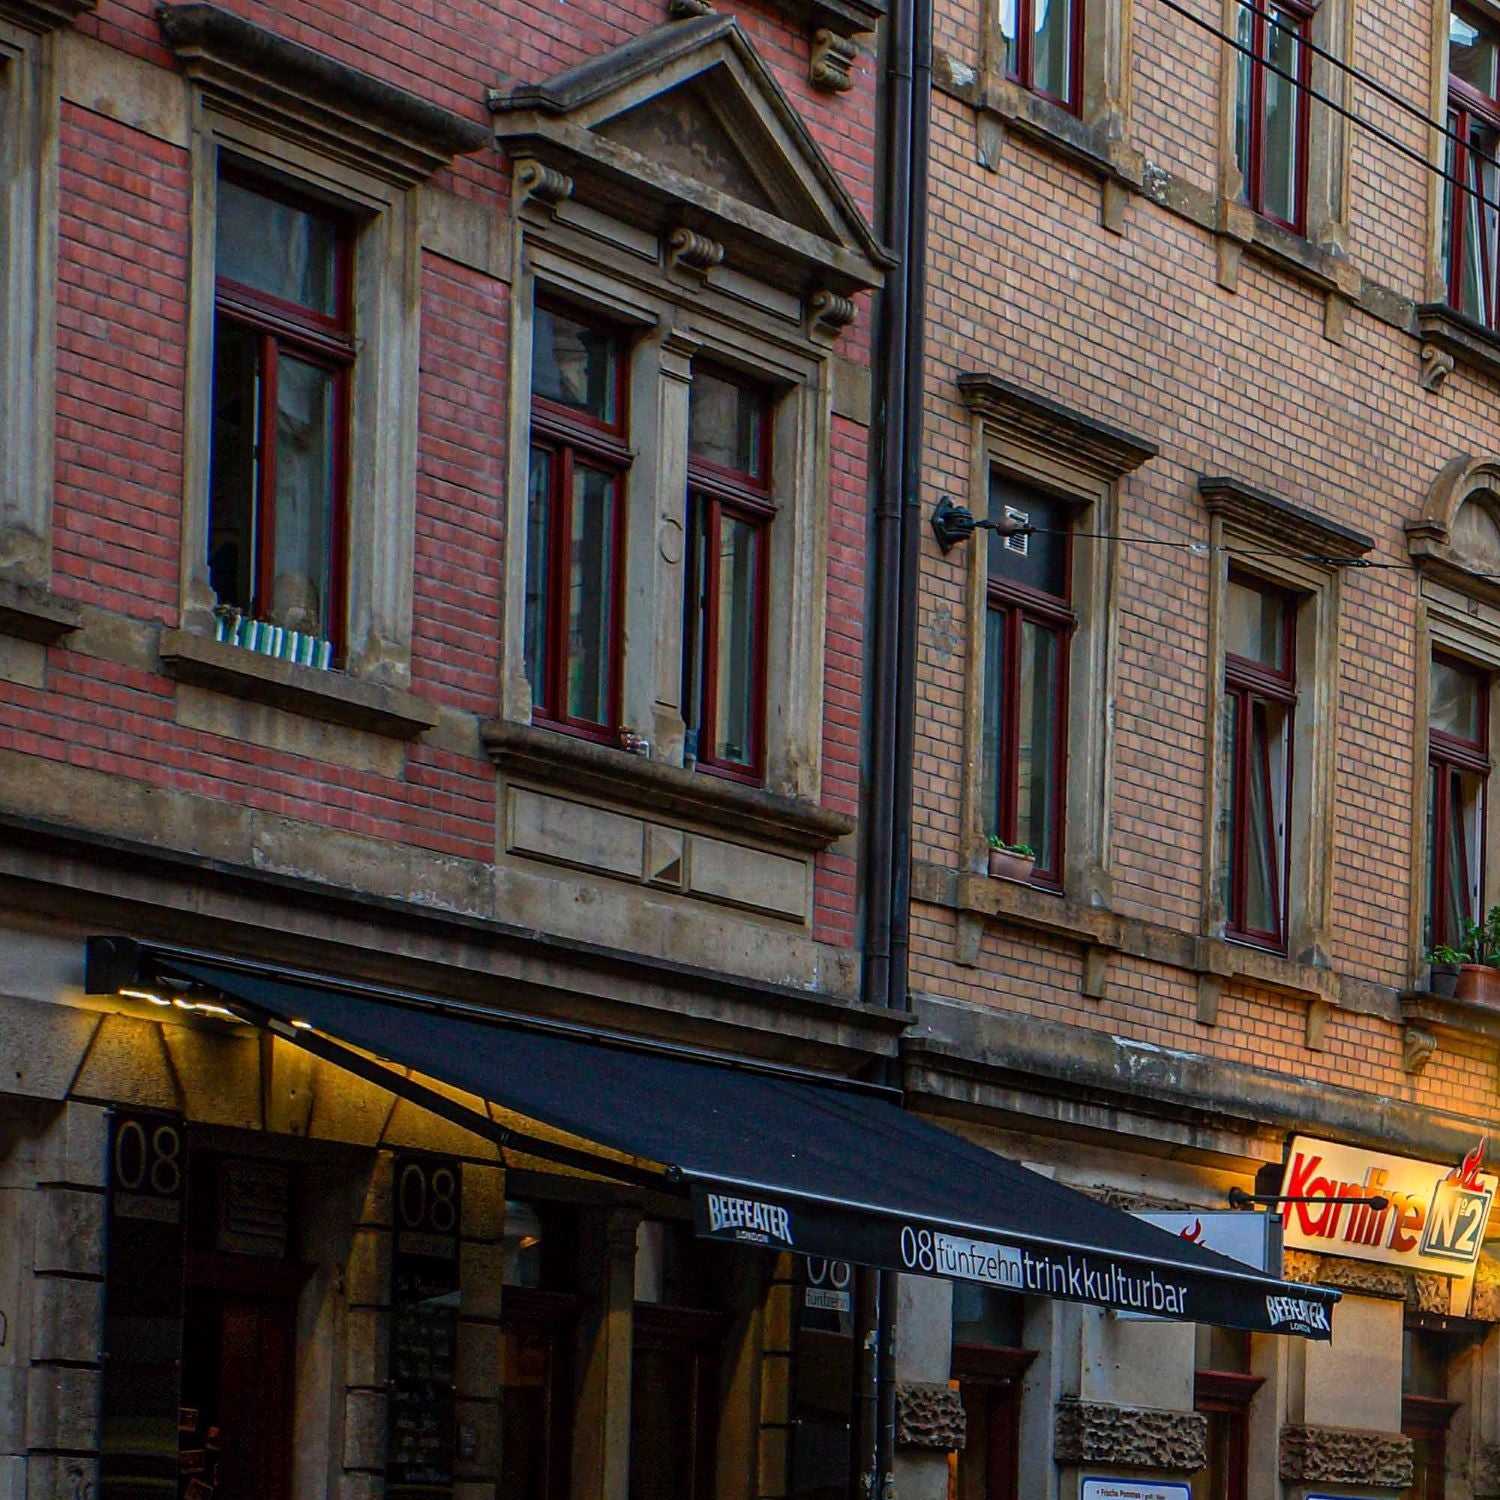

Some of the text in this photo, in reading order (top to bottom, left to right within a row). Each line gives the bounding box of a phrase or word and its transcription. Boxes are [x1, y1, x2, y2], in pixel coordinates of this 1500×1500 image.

[115, 1121, 180, 1193] 08
[707, 1193, 794, 1245] BEEFEATER
[735, 1230, 768, 1243] LONDON
[901, 1226, 1187, 1314] 08 fünfzehn trinkkulturbar
[1265, 1295, 1330, 1332] BEEFEATER
